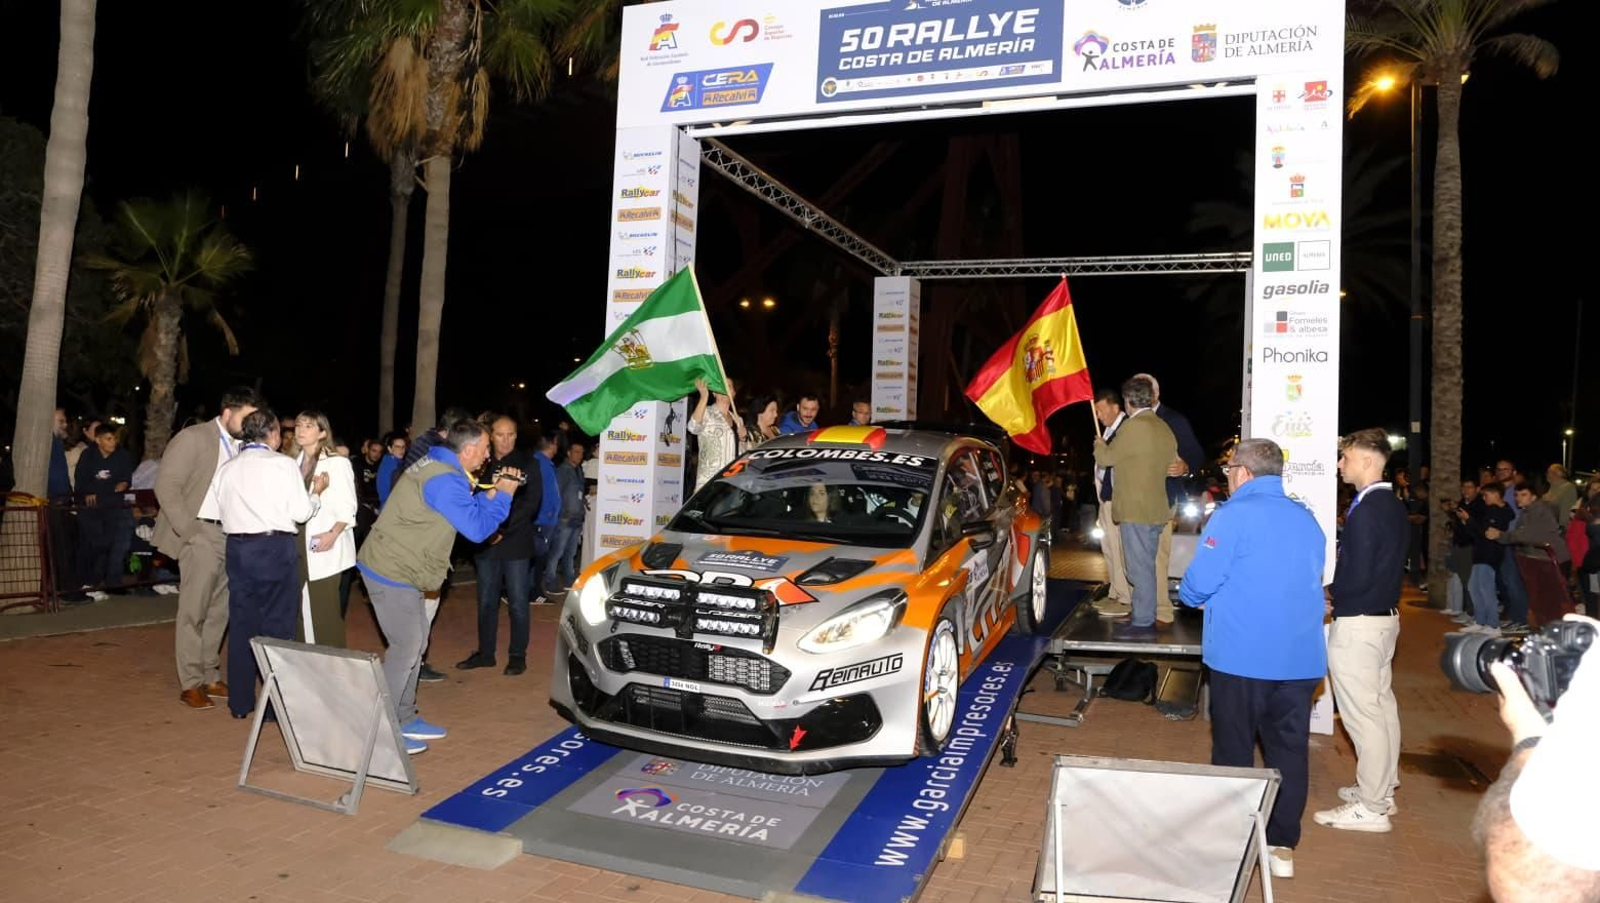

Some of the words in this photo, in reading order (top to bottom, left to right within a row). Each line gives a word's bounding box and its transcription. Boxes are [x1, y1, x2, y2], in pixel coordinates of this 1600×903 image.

[840, 26, 884, 53] 50
[886, 8, 1039, 48] RALLYE
[1225, 24, 1318, 45] DIPUTACIÓN
[1113, 40, 1155, 53] COSTA
[1159, 38, 1175, 48] DE
[1225, 46, 1243, 58] DE
[838, 52, 903, 70] COSTA
[906, 49, 935, 64] DE
[938, 37, 1035, 61] ALMERÍA
[1099, 49, 1176, 71] ALMERÍA
[702, 70, 759, 87] CERA
[712, 90, 748, 103] Recalvi
[621, 188, 661, 199] Rallycar
[1265, 252, 1292, 262] UNED
[616, 268, 656, 279] Rallycar
[1263, 280, 1330, 300] gasolia
[1299, 325, 1328, 333] albesa
[1263, 347, 1328, 363] Phonika
[608, 429, 647, 442] Rallycar
[748, 448, 923, 467] COLOMBES.ES
[604, 513, 644, 525] Rallycar
[725, 554, 779, 564] RALLYE
[874, 661, 1015, 866] www.garciaimpresores.es
[690, 771, 718, 782] DE
[676, 803, 745, 822] COSTA
[751, 814, 782, 827] DE
[640, 810, 768, 841] ALMERÍA
